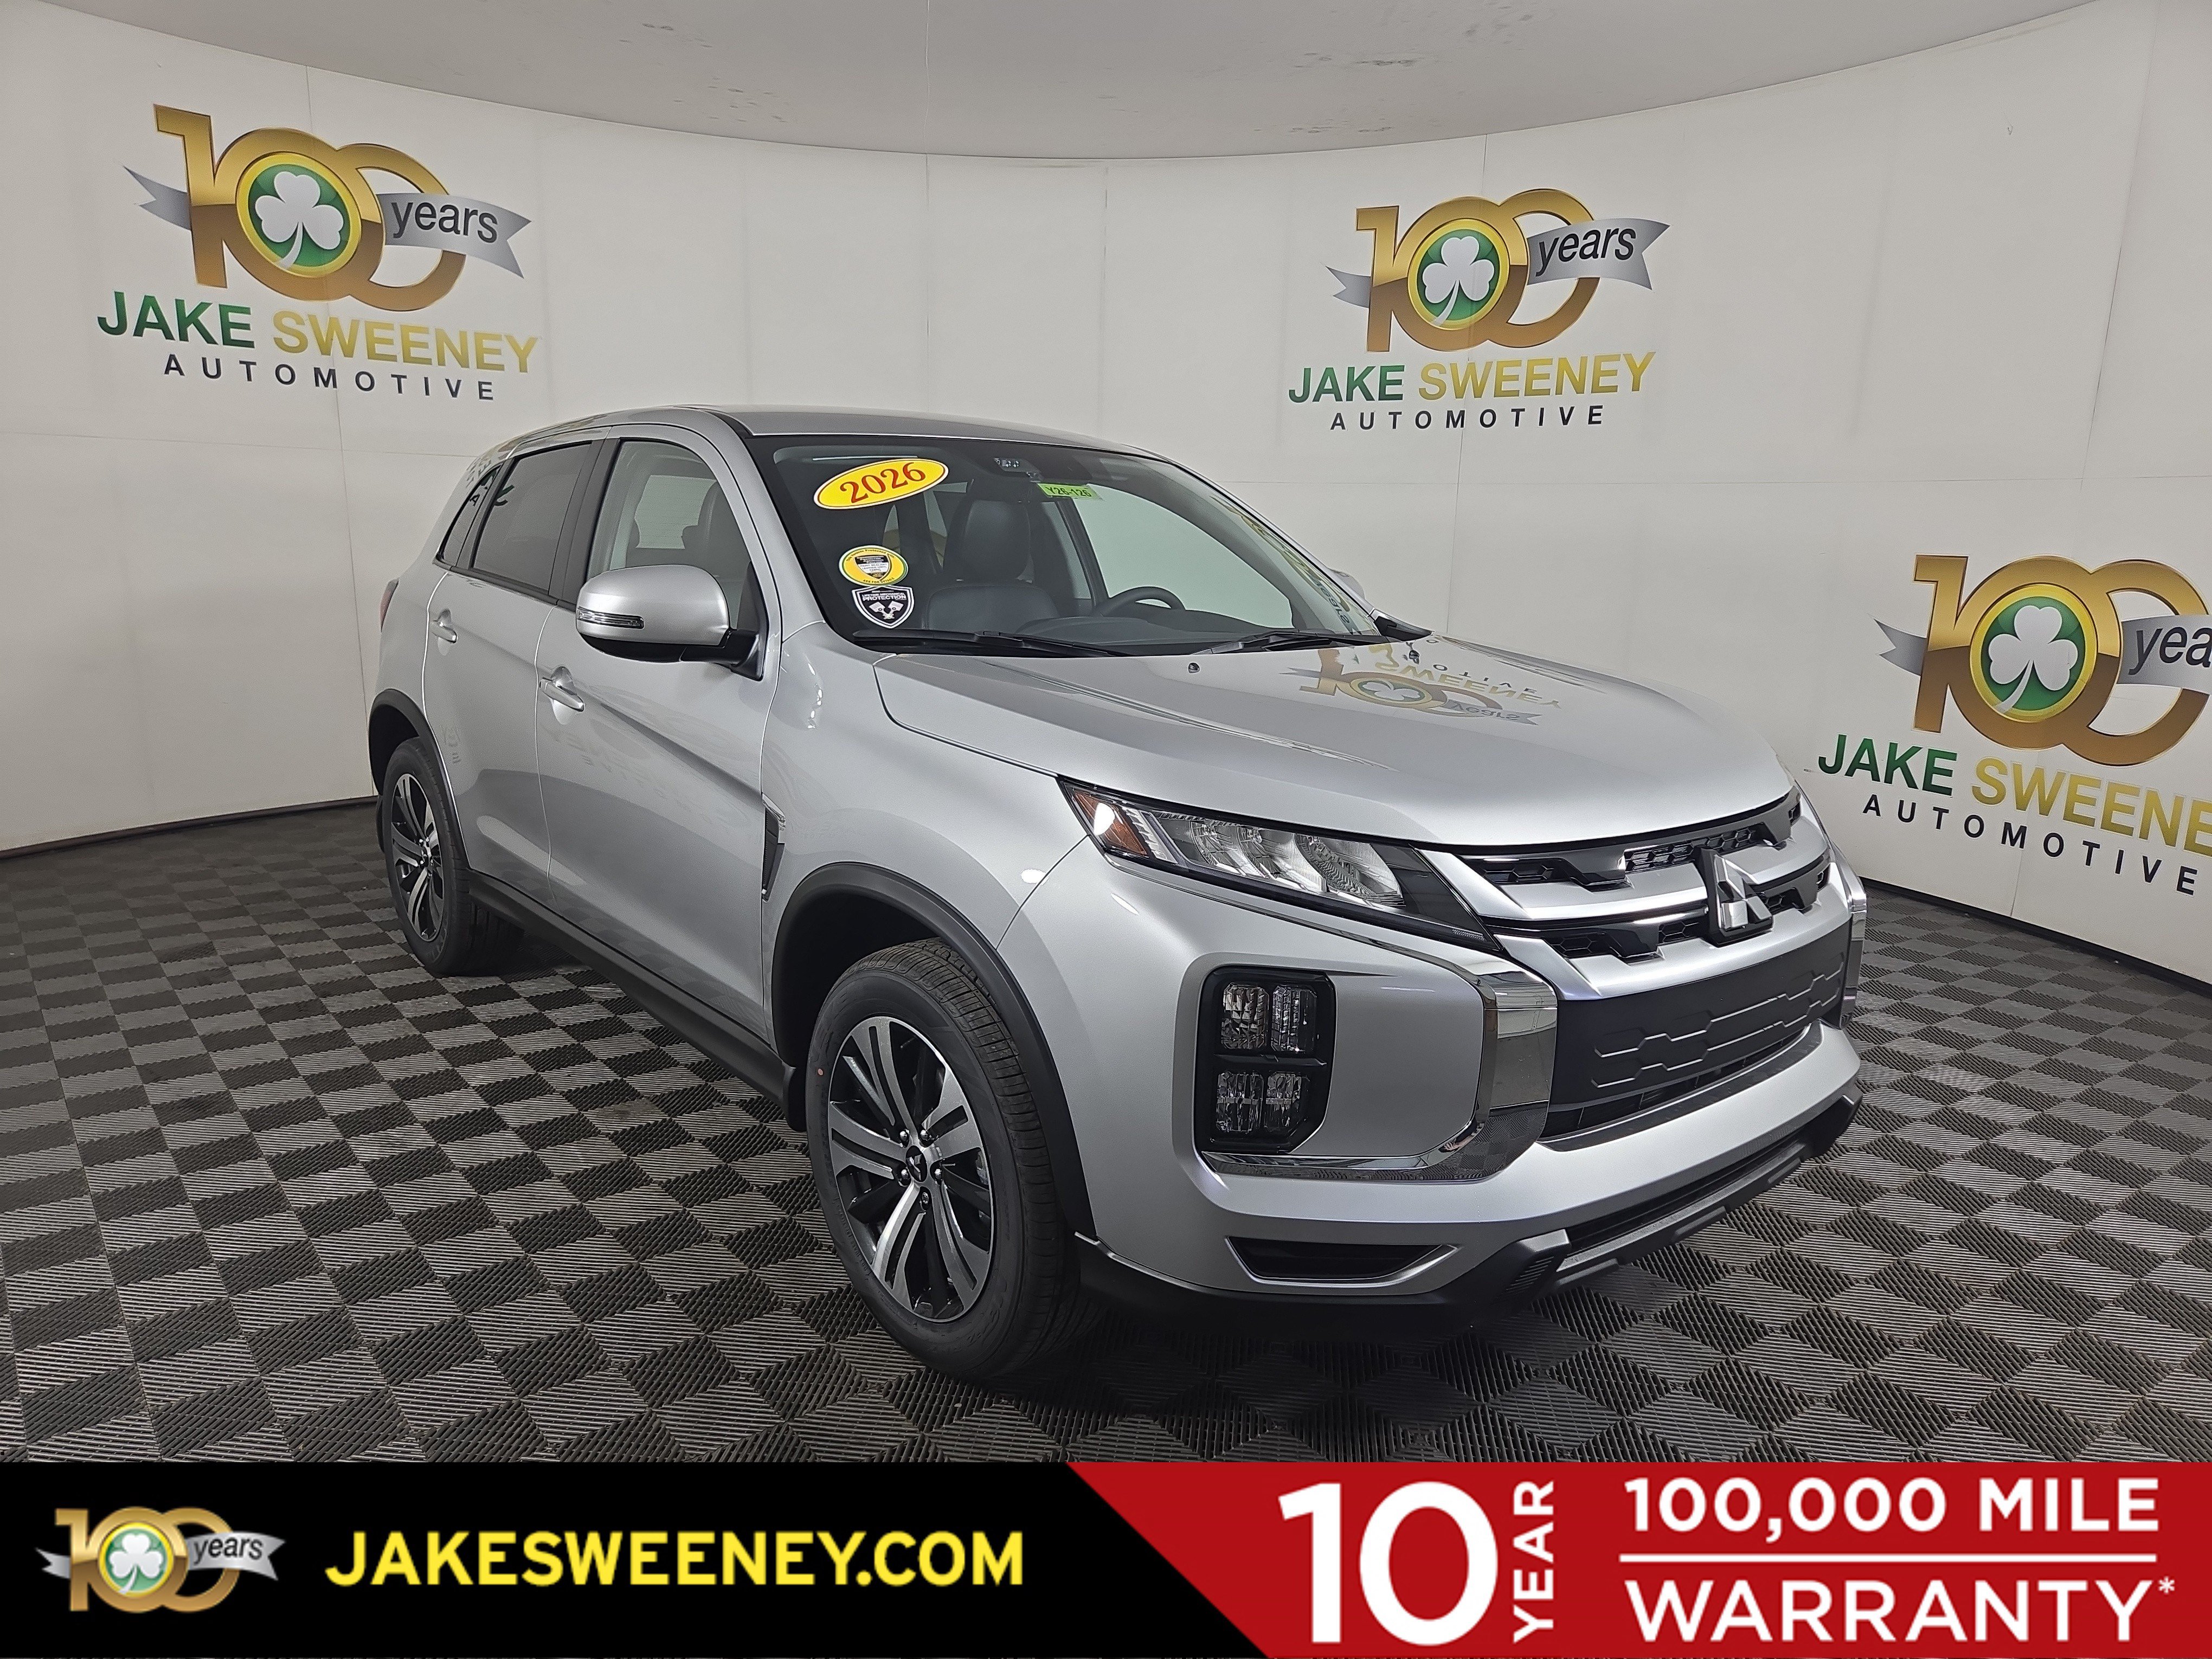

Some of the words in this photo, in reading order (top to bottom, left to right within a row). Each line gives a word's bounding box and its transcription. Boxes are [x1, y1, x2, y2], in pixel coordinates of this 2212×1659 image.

[153, 104, 467, 312] 100
[391, 201, 499, 243] years
[1356, 188, 1600, 352] 100
[1534, 227, 1636, 278] years
[97, 291, 256, 349] JAKE
[273, 310, 538, 375] SWEENEY
[164, 353, 496, 401] AUTOMOTIVE
[1288, 364, 1405, 403] JAKE
[1418, 351, 1656, 401] SWEENEY
[1330, 404, 1604, 431] AUTOMOTIVE
[839, 461, 927, 505] 2026
[1044, 486, 1092, 497] Y26-126
[1913, 554, 2211, 767] 100
[1818, 734, 1958, 797] JAKE
[1862, 794, 2198, 896] AUTOMOTIVE
